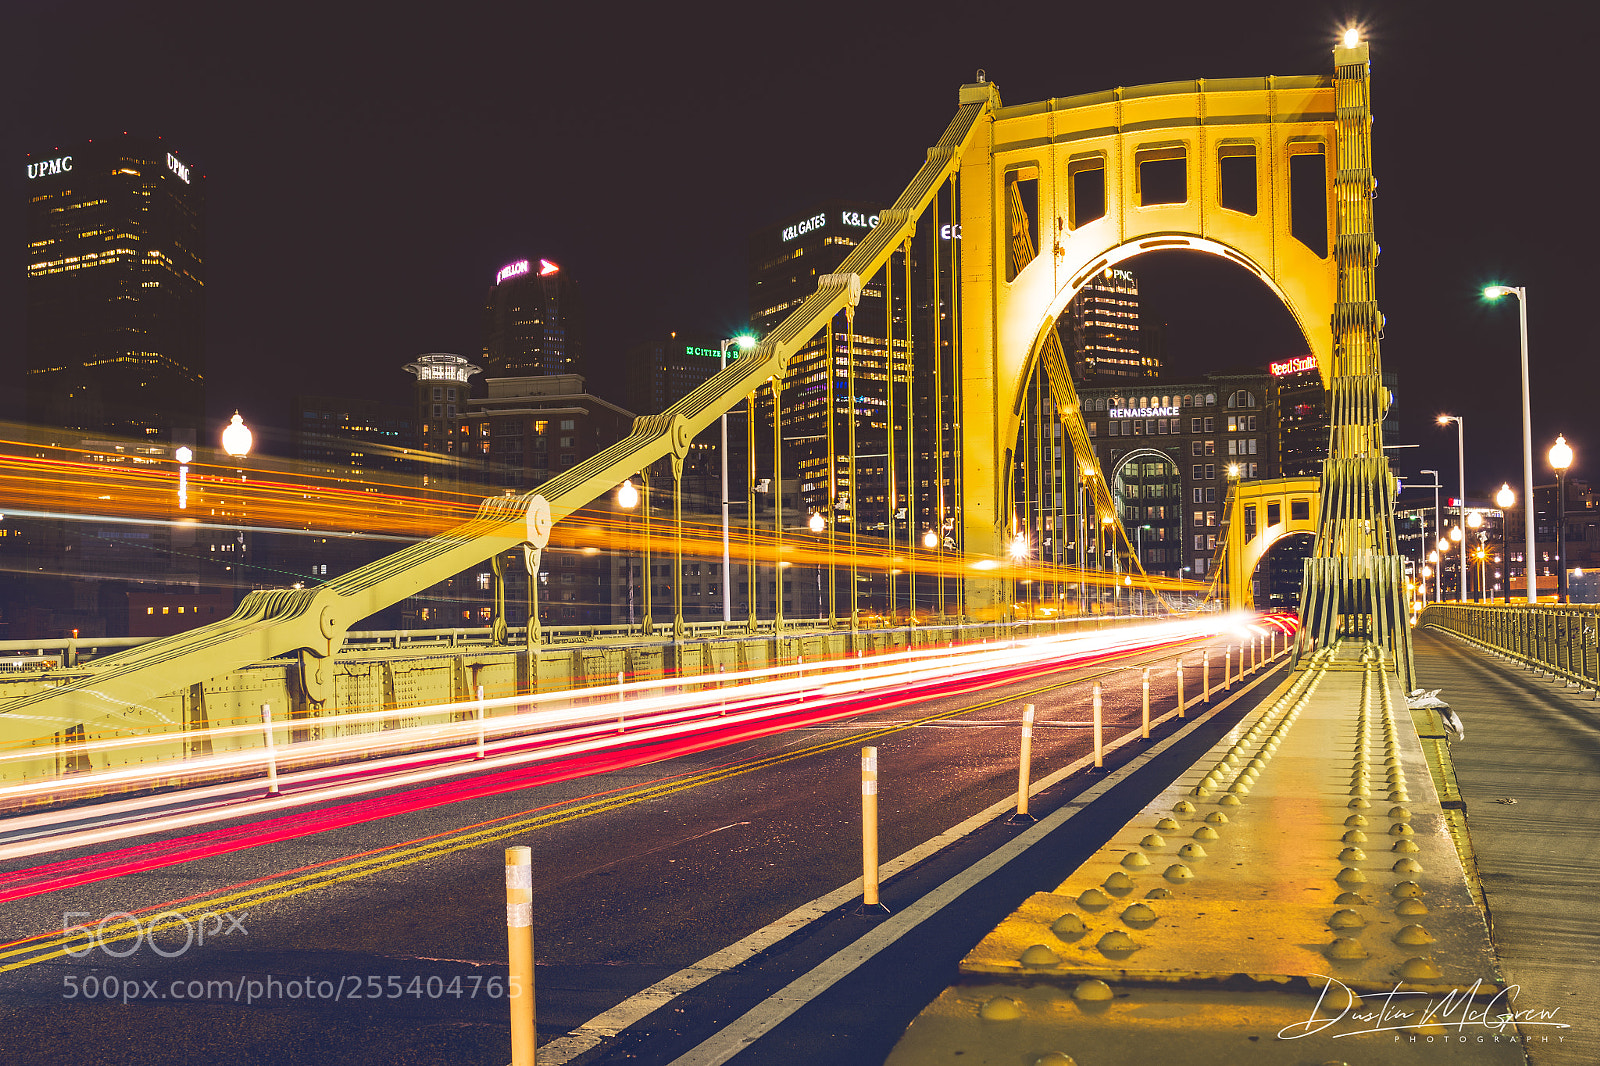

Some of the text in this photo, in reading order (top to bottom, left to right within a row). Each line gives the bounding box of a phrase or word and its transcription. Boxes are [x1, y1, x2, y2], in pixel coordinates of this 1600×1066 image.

[28, 156, 73, 179] UPMC
[167, 152, 190, 184] UPMC
[782, 213, 826, 242] K&L GATES
[842, 211, 867, 228] K&L
[1113, 269, 1133, 281] PNC
[694, 347, 731, 359] CITIZES
[1270, 359, 1293, 376] Reed
[1109, 406, 1180, 418] RENAISSANCE
